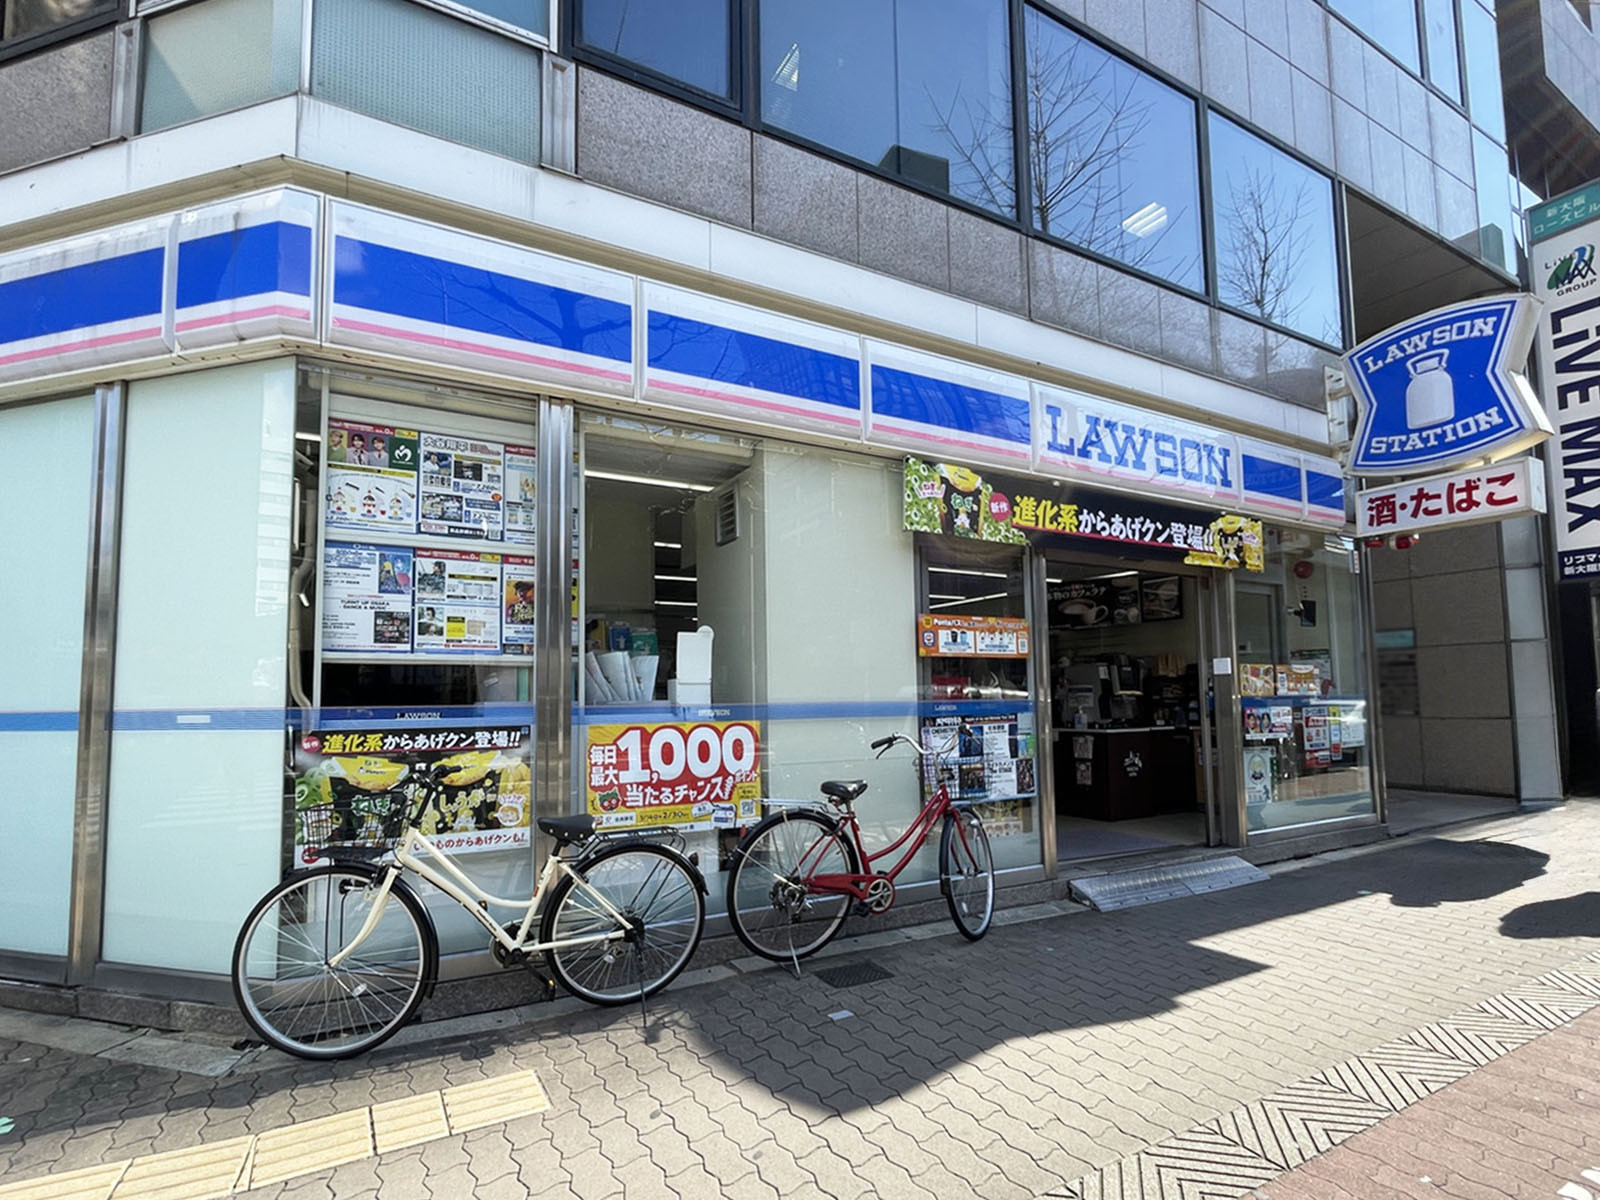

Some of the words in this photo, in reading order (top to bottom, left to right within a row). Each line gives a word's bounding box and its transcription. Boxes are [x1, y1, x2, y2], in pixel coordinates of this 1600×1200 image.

[1546, 195, 1586, 217] 新大阪
[1557, 278, 1597, 297] GROUP
[1364, 316, 1498, 374] LAWSON
[1370, 406, 1504, 455] STATION
[1046, 404, 1233, 489] LAWSON
[1367, 473, 1519, 527] 酒・たばこ
[1012, 494, 1215, 552] 進化系からあげクン登場!!
[1564, 563, 1600, 575] 新大阪
[396, 712, 441, 720] LAWSON
[321, 730, 521, 753] 進化系からあげクン登場!!
[590, 745, 617, 765] 毎日
[615, 724, 757, 785] 1,000
[590, 766, 618, 787] 最大
[413, 832, 526, 852] いものからあげクンも!
